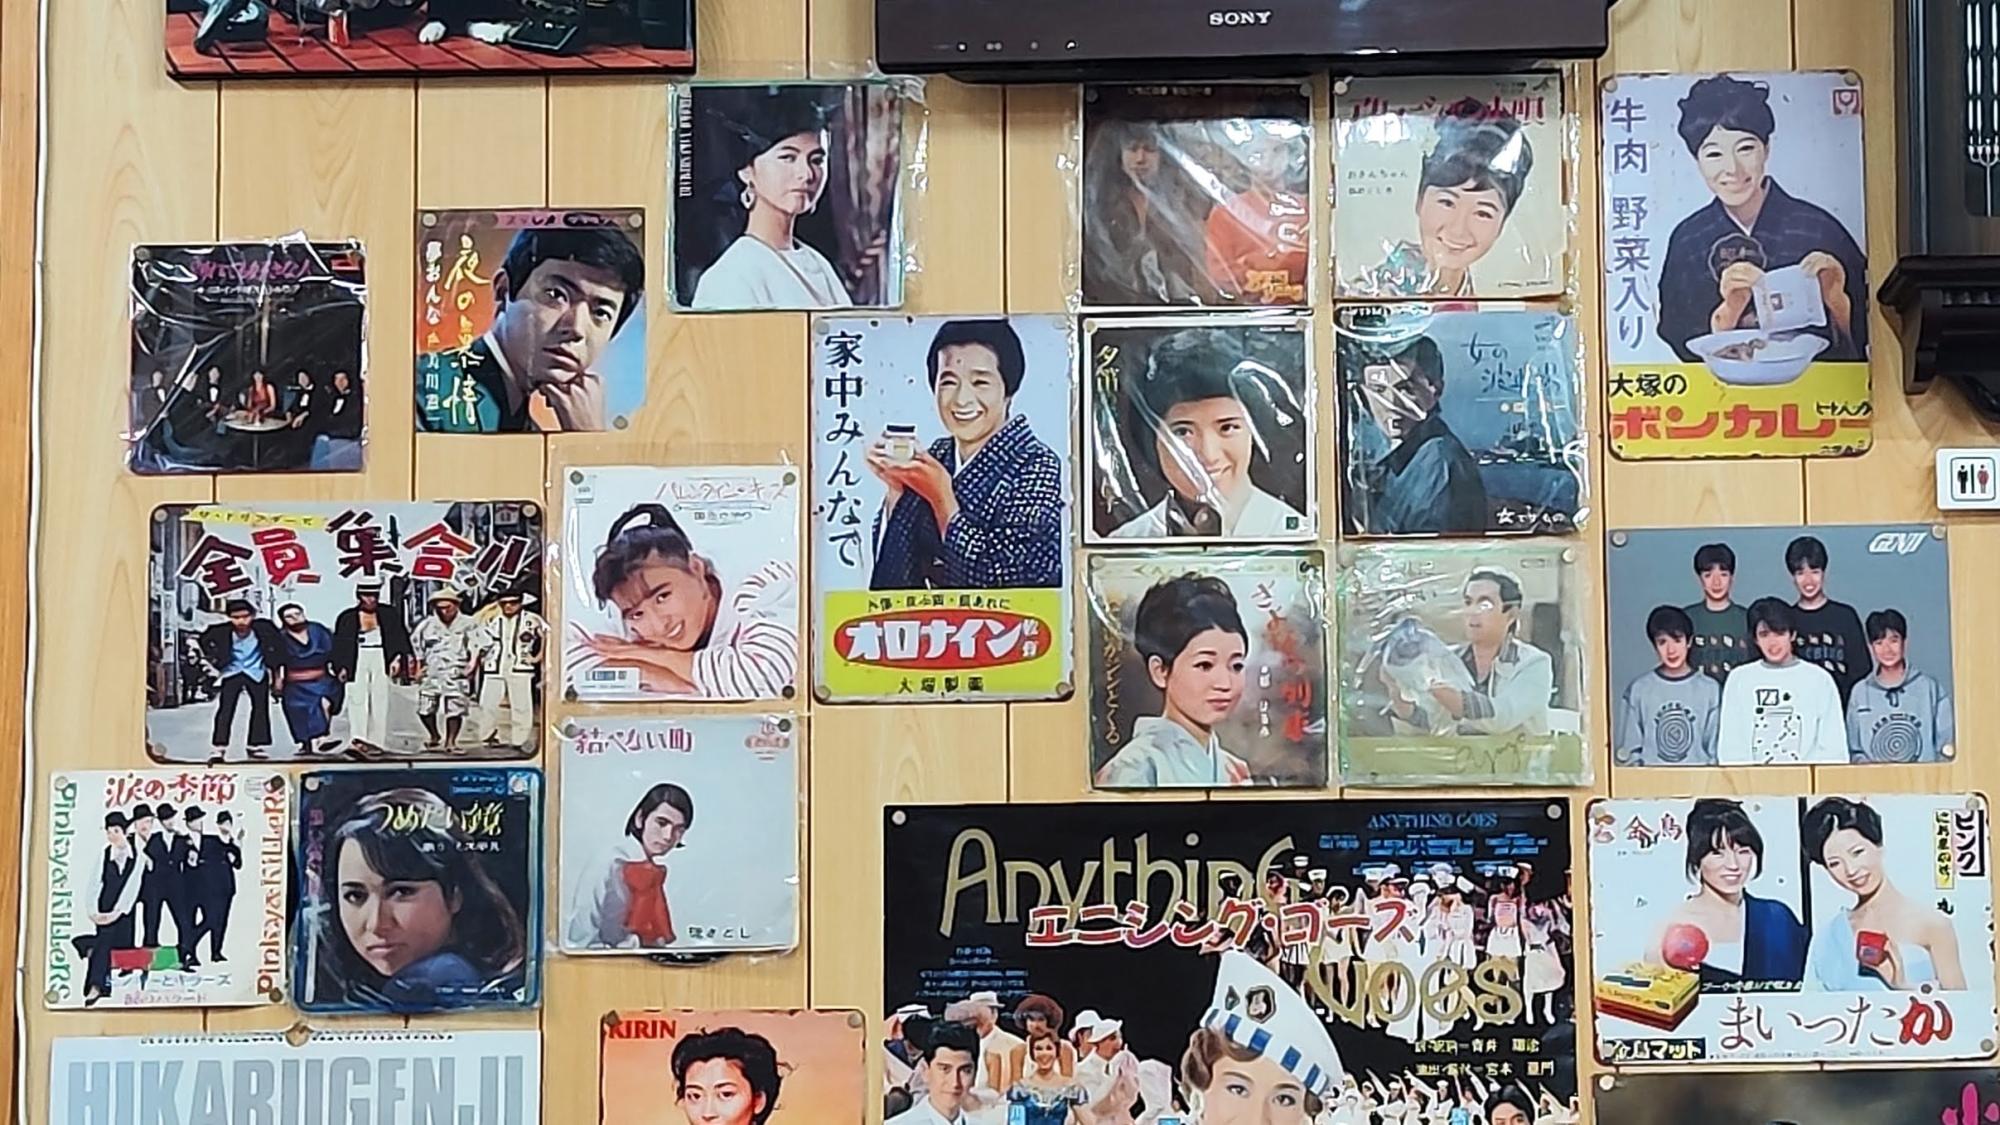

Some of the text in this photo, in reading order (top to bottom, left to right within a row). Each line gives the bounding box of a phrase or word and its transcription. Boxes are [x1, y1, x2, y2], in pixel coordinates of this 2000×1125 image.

[1208, 11, 1272, 26] SONY
[1611, 97, 1648, 174] 牛肉
[1612, 196, 1650, 349] 野菜入り
[1609, 372, 1687, 398] 大塚の
[1611, 403, 1871, 439] ボンカレー
[825, 331, 864, 567] 家中みんなで
[845, 618, 1023, 660] オロナイン
[1367, 814, 1452, 829] ANYTHING
[608, 1020, 677, 1039] KIRIN
[1719, 996, 1953, 1050] まいったか
